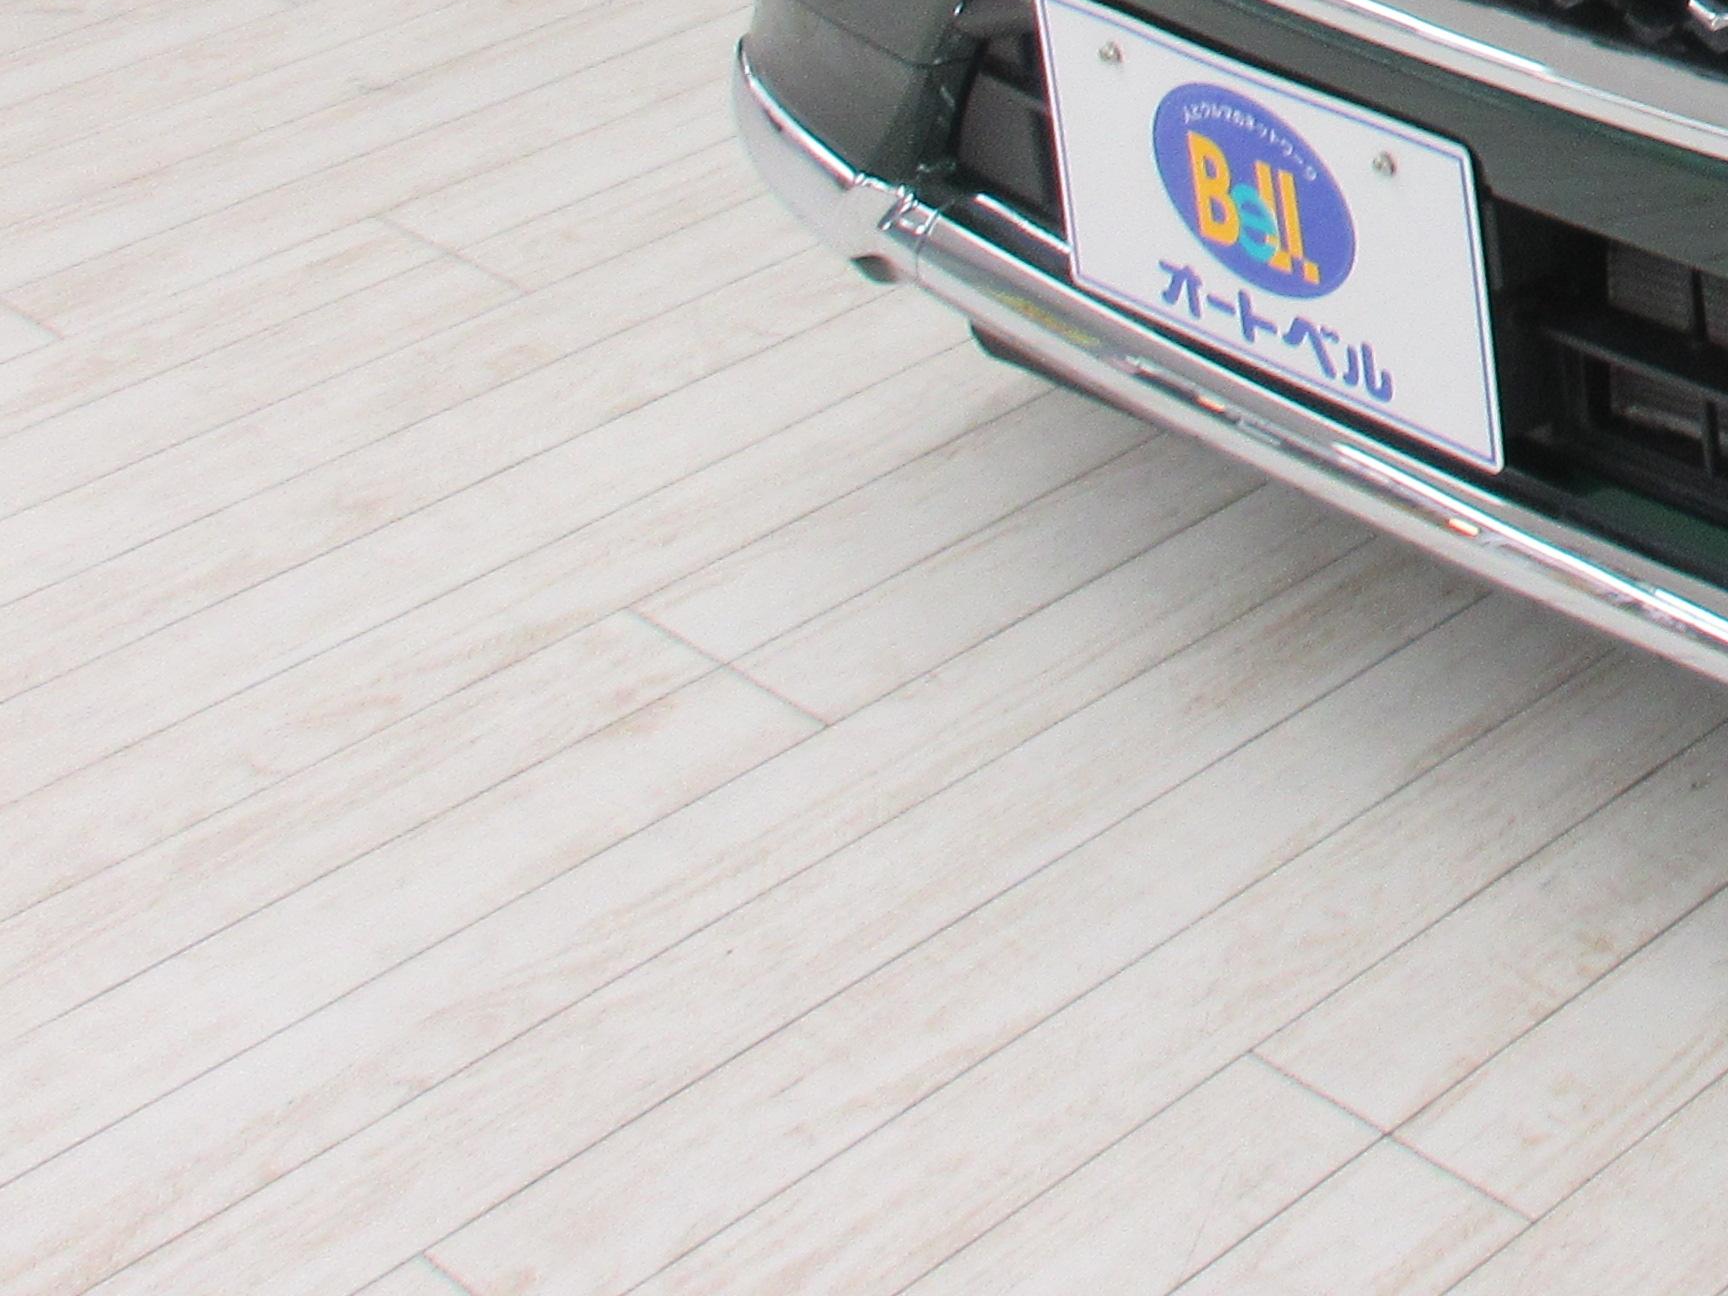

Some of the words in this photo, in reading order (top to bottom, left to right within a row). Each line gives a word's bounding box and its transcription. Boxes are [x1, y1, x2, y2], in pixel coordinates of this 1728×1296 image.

[1158, 259, 1394, 404] オートベル
